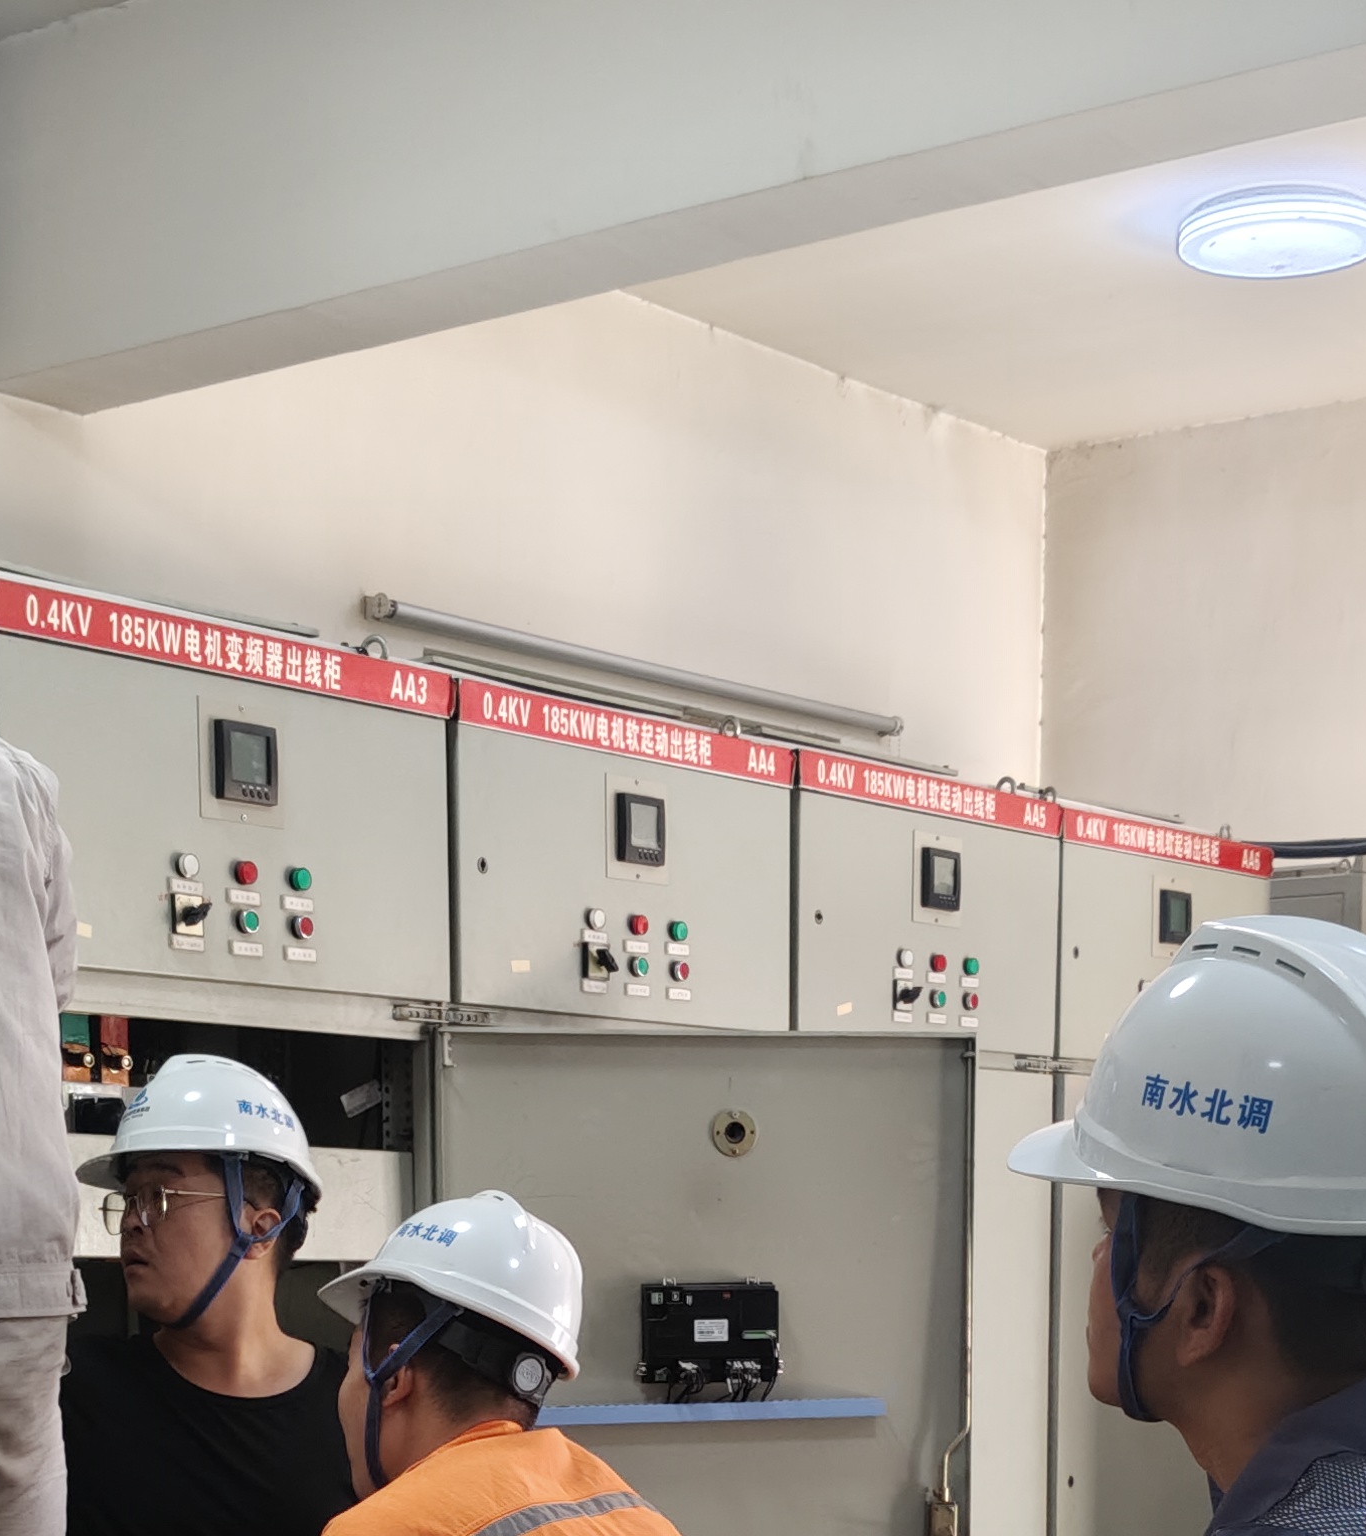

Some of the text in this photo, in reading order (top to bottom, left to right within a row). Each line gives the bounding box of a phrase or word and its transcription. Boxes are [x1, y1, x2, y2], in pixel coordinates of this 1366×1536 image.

[25, 594, 429, 705] 0.4KV 185KW电机变频器出线柜 AA3
[482, 691, 777, 777] 0.4KV 185KW电机软起动出线柜 AA4
[817, 759, 1048, 829] 0.4KV 185KW电机软起动出线柜 AA5
[1076, 815, 1108, 842] 0.4KV
[237, 1099, 295, 1130] 南水北调
[1140, 1073, 1274, 1134] 南水北调
